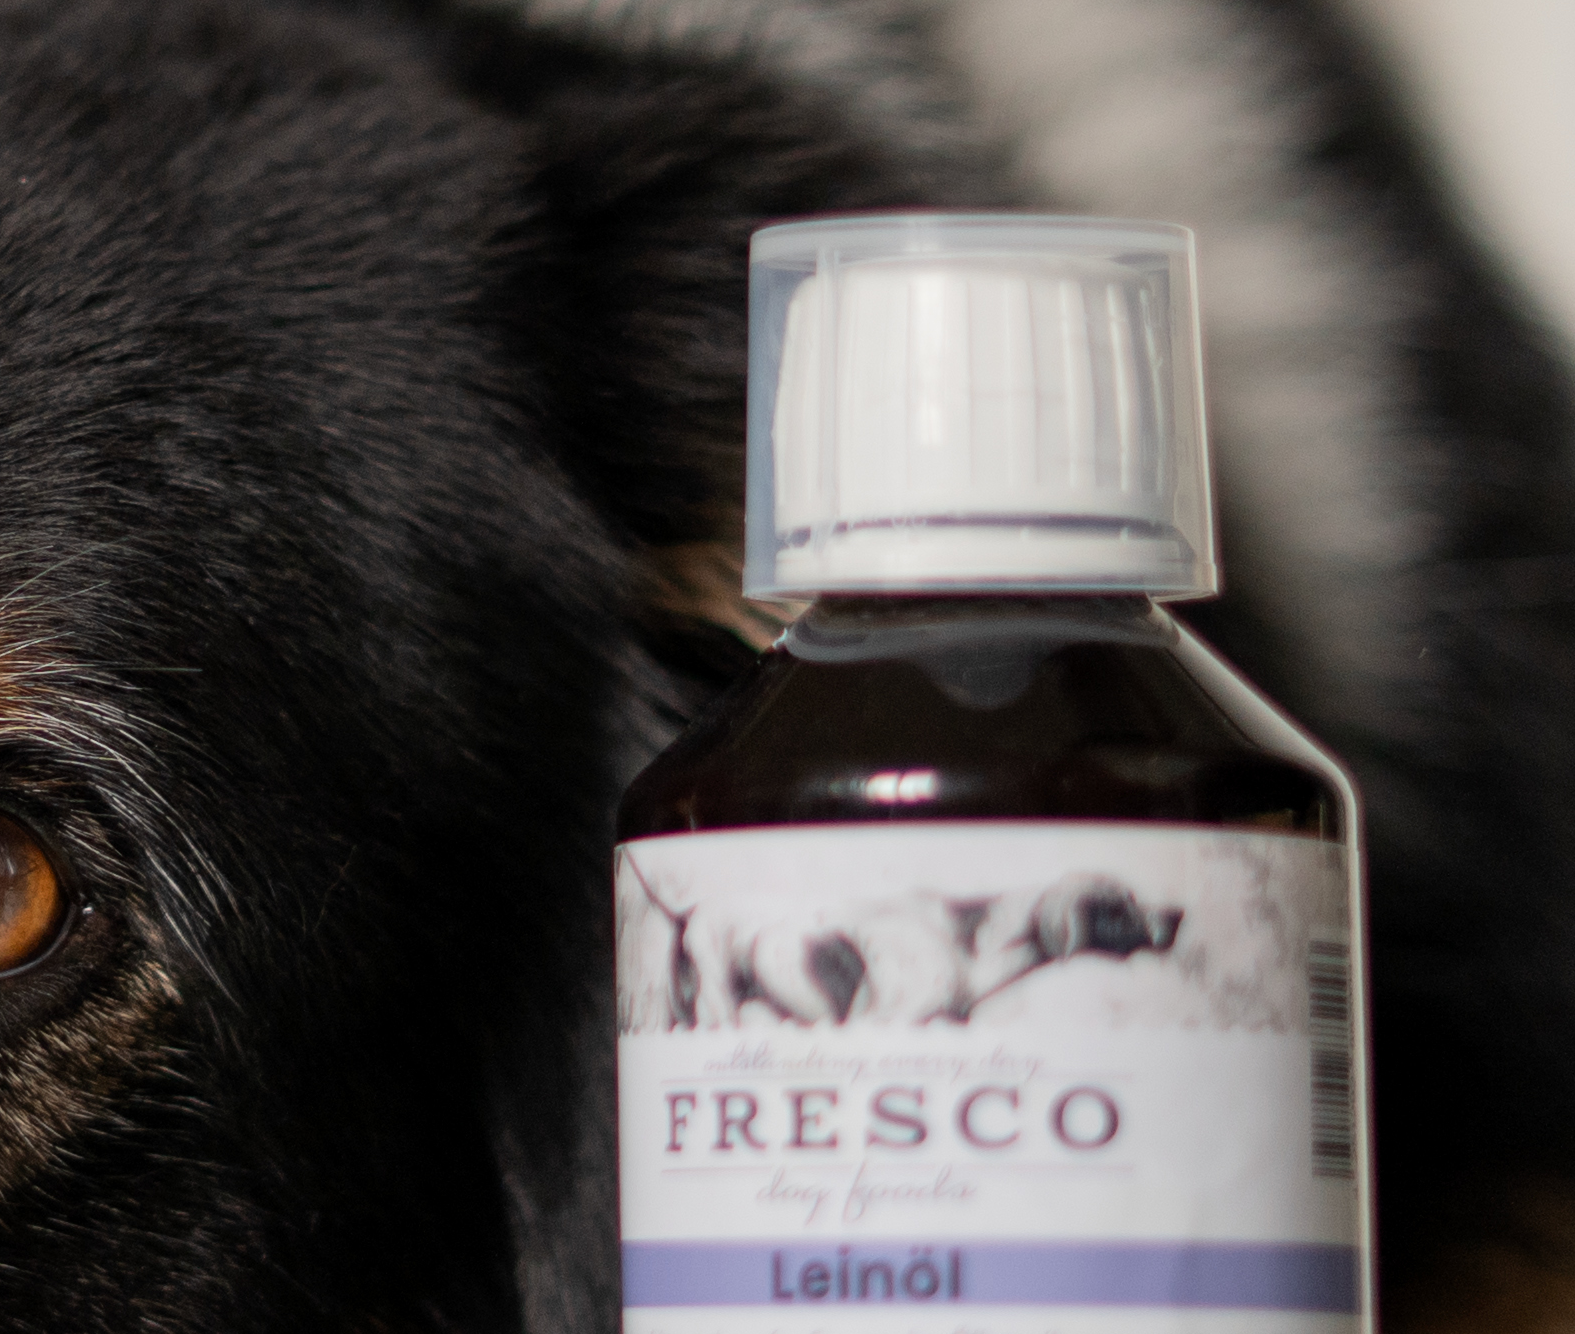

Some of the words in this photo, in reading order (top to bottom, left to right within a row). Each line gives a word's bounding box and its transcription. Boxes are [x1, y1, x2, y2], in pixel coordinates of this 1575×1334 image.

[664, 1085, 1122, 1154] FRESCO
[756, 1168, 832, 1227] dog
[840, 1160, 977, 1225] foods
[769, 1243, 964, 1303] Leinöl
